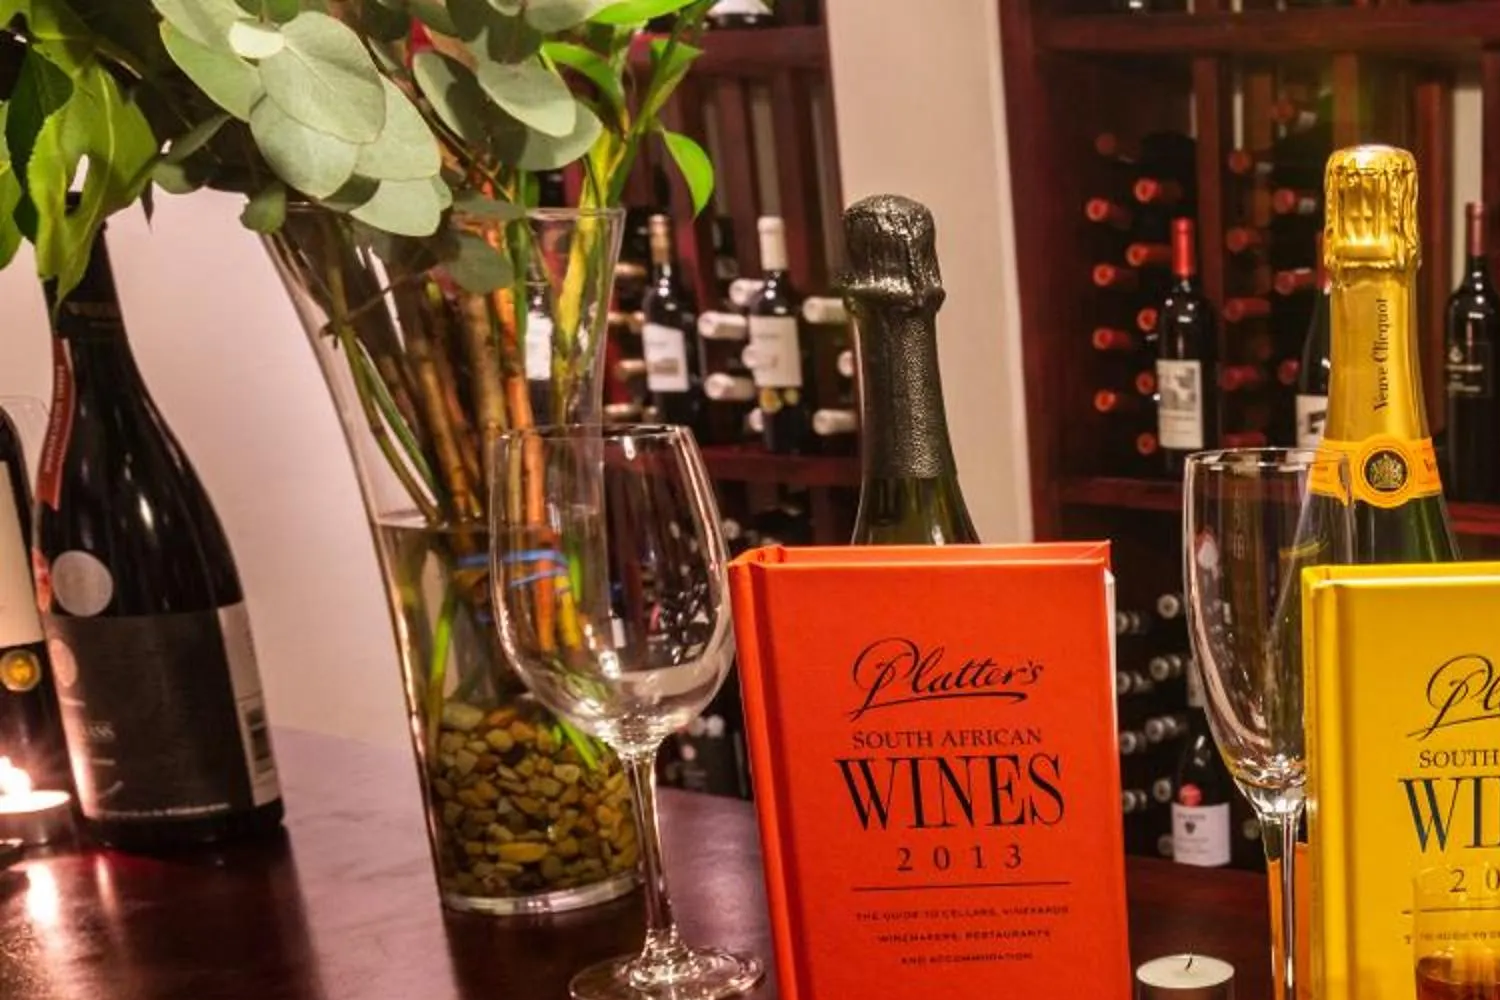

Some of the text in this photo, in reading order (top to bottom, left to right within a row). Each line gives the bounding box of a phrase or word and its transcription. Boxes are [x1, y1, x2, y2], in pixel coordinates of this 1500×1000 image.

[1373, 297, 1390, 411] Veuve Clicquot
[847, 637, 1045, 722] Platter's
[852, 728, 1042, 750] SOUTH AFRICAN
[1419, 749, 1499, 769] SOUTH
[834, 752, 1065, 832] WINES
[897, 844, 1022, 871] 2013
